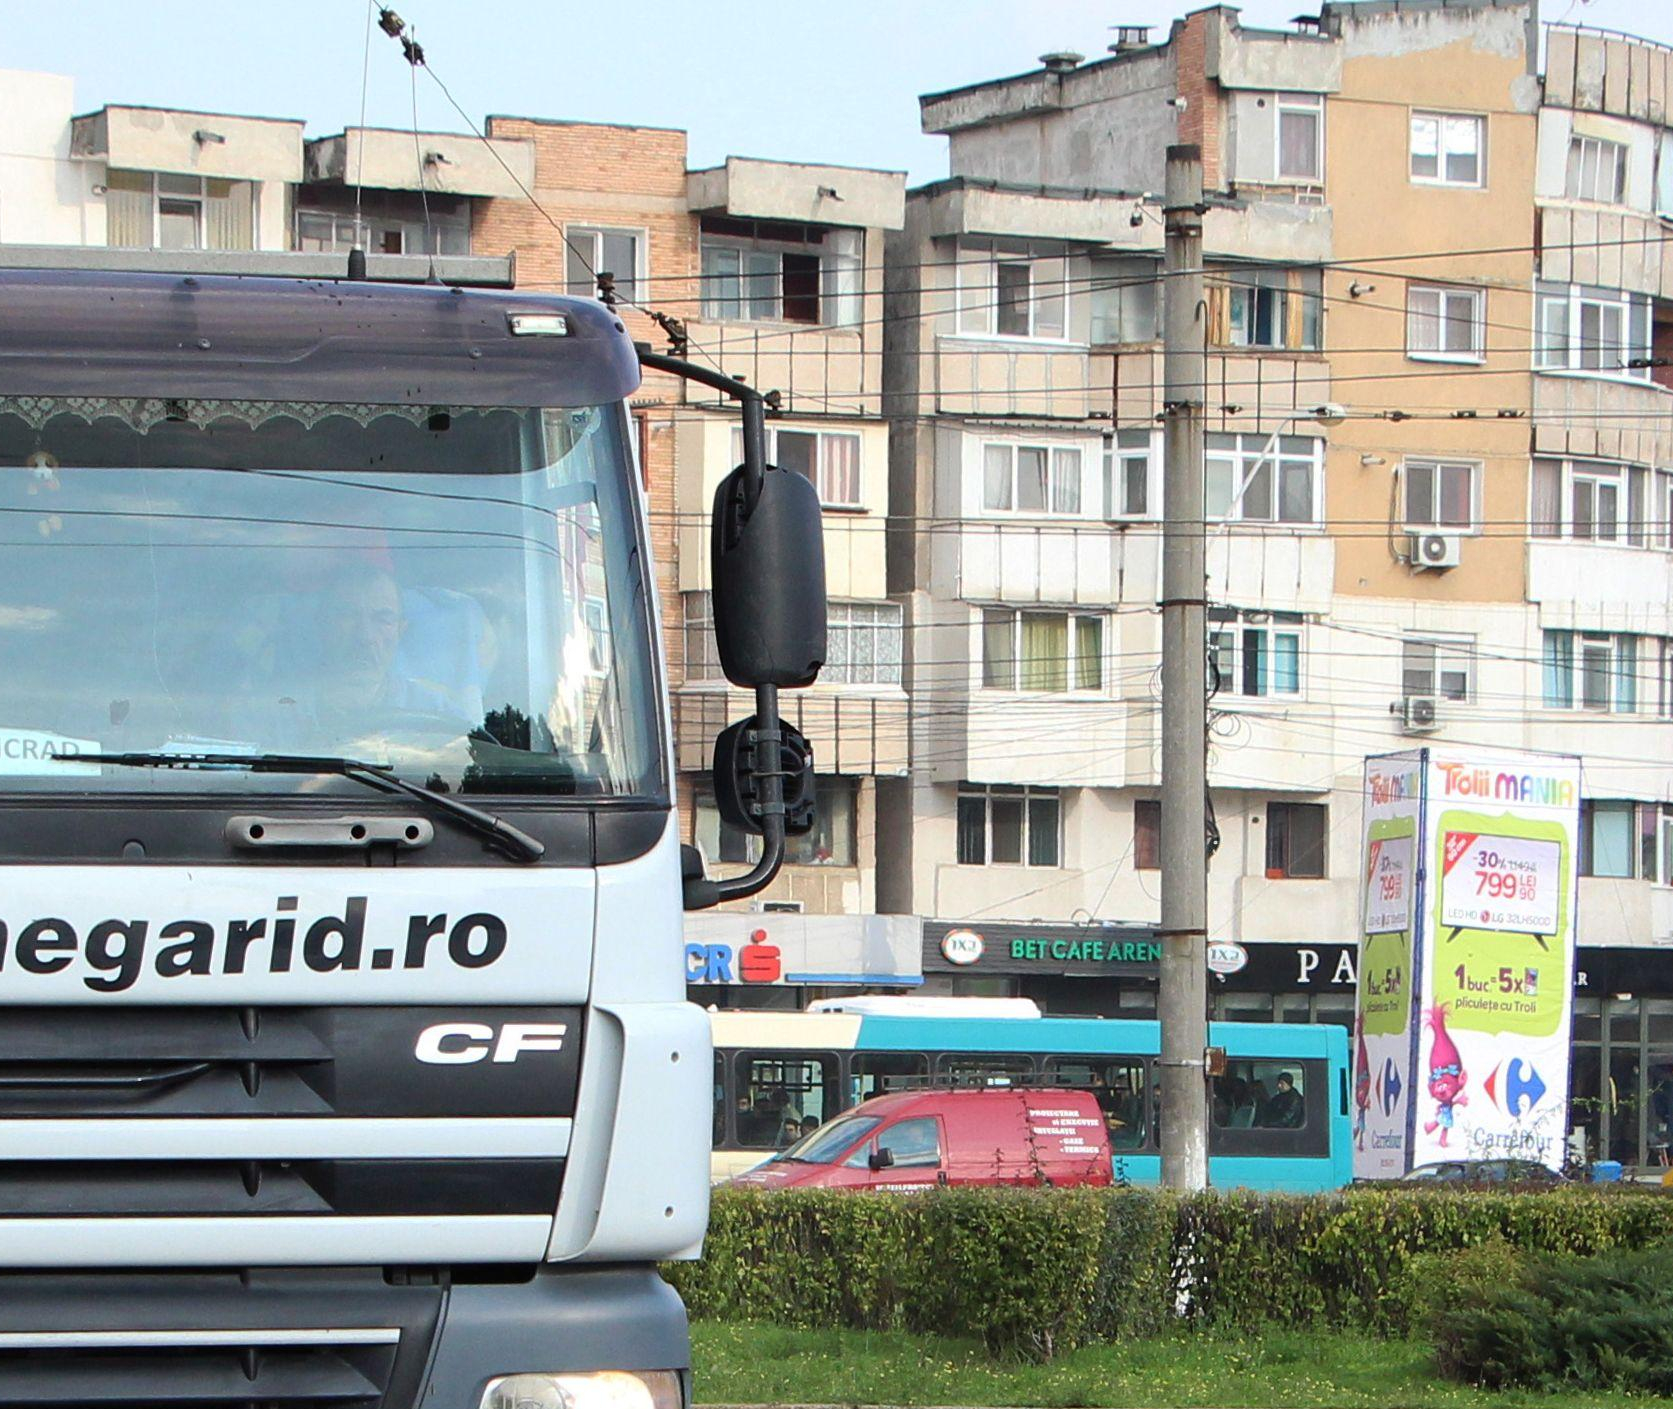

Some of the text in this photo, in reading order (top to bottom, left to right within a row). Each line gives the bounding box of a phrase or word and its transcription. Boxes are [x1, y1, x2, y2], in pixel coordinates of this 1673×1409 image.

[1475, 870, 1516, 899] 799
[1520, 875, 1537, 887] LEI
[1520, 888, 1536, 901] 90
[1492, 913, 1504, 923] LG
[1011, 939, 1162, 961] BET CAFE AREN
[685, 942, 733, 982] CR
[414, 1023, 567, 1064] CF
[1473, 1127, 1552, 1150] Carrefour
